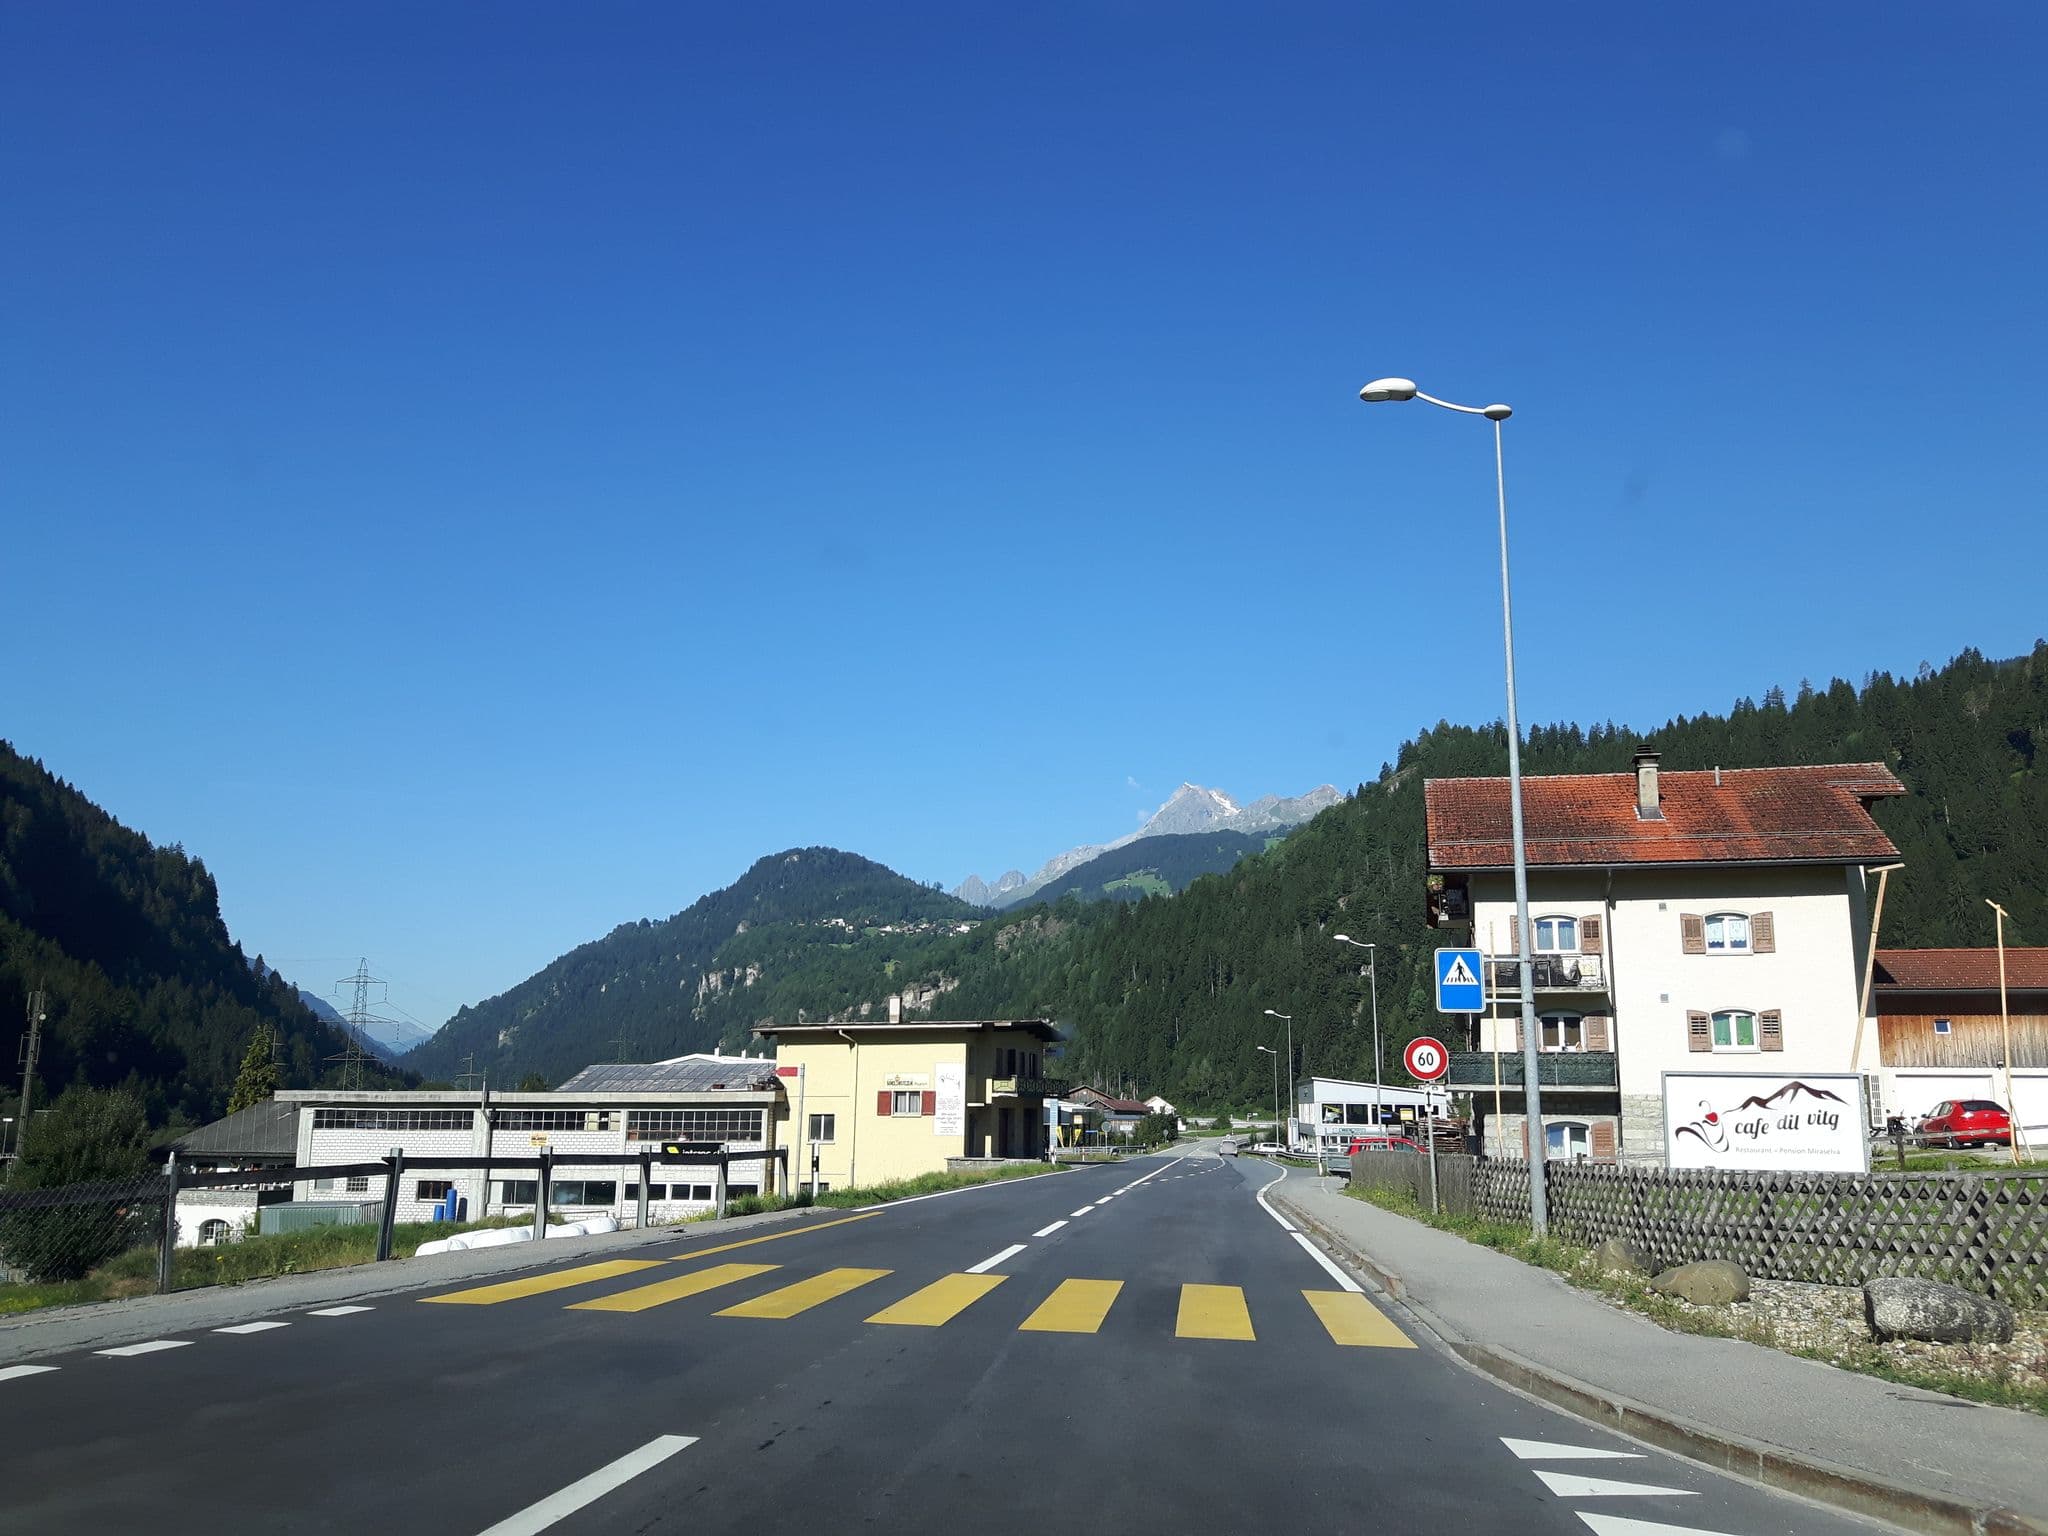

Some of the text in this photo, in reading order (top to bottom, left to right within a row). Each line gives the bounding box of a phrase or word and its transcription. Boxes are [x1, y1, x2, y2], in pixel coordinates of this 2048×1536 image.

[1418, 1052, 1434, 1066] 60
[1735, 1117, 1770, 1140] cafe
[1776, 1114, 1800, 1130] dil
[1735, 1146, 1772, 1154] Restaurant
[1779, 1147, 1807, 1155] Pension
